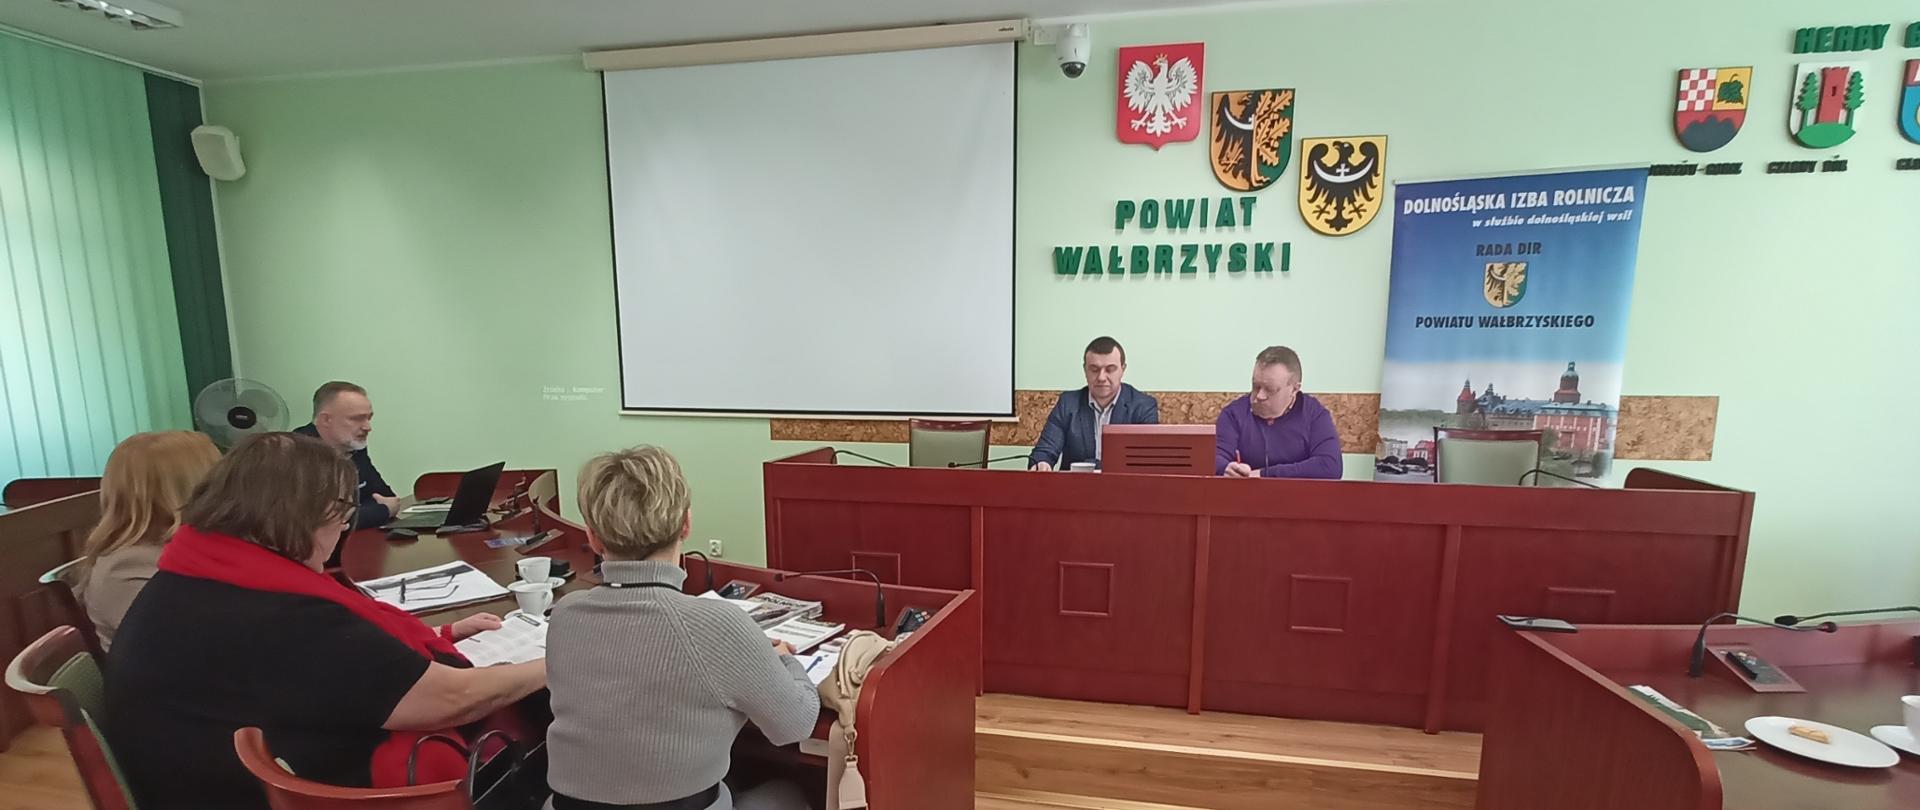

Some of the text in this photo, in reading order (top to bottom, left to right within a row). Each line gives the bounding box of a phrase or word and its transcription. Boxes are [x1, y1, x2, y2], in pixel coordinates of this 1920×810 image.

[1793, 24, 1890, 53] HERBY
[1115, 196, 1257, 229] POWIAT
[1403, 185, 1635, 215] DOLNOŚLĄSKA IZBA ROLNICZA
[1472, 219, 1483, 228] w
[1053, 242, 1291, 275] WAŁBRZYSKI
[1476, 242, 1542, 257] RADA DIR
[1415, 314, 1595, 329] POWIATU WAŁBRZYSKIEGO
